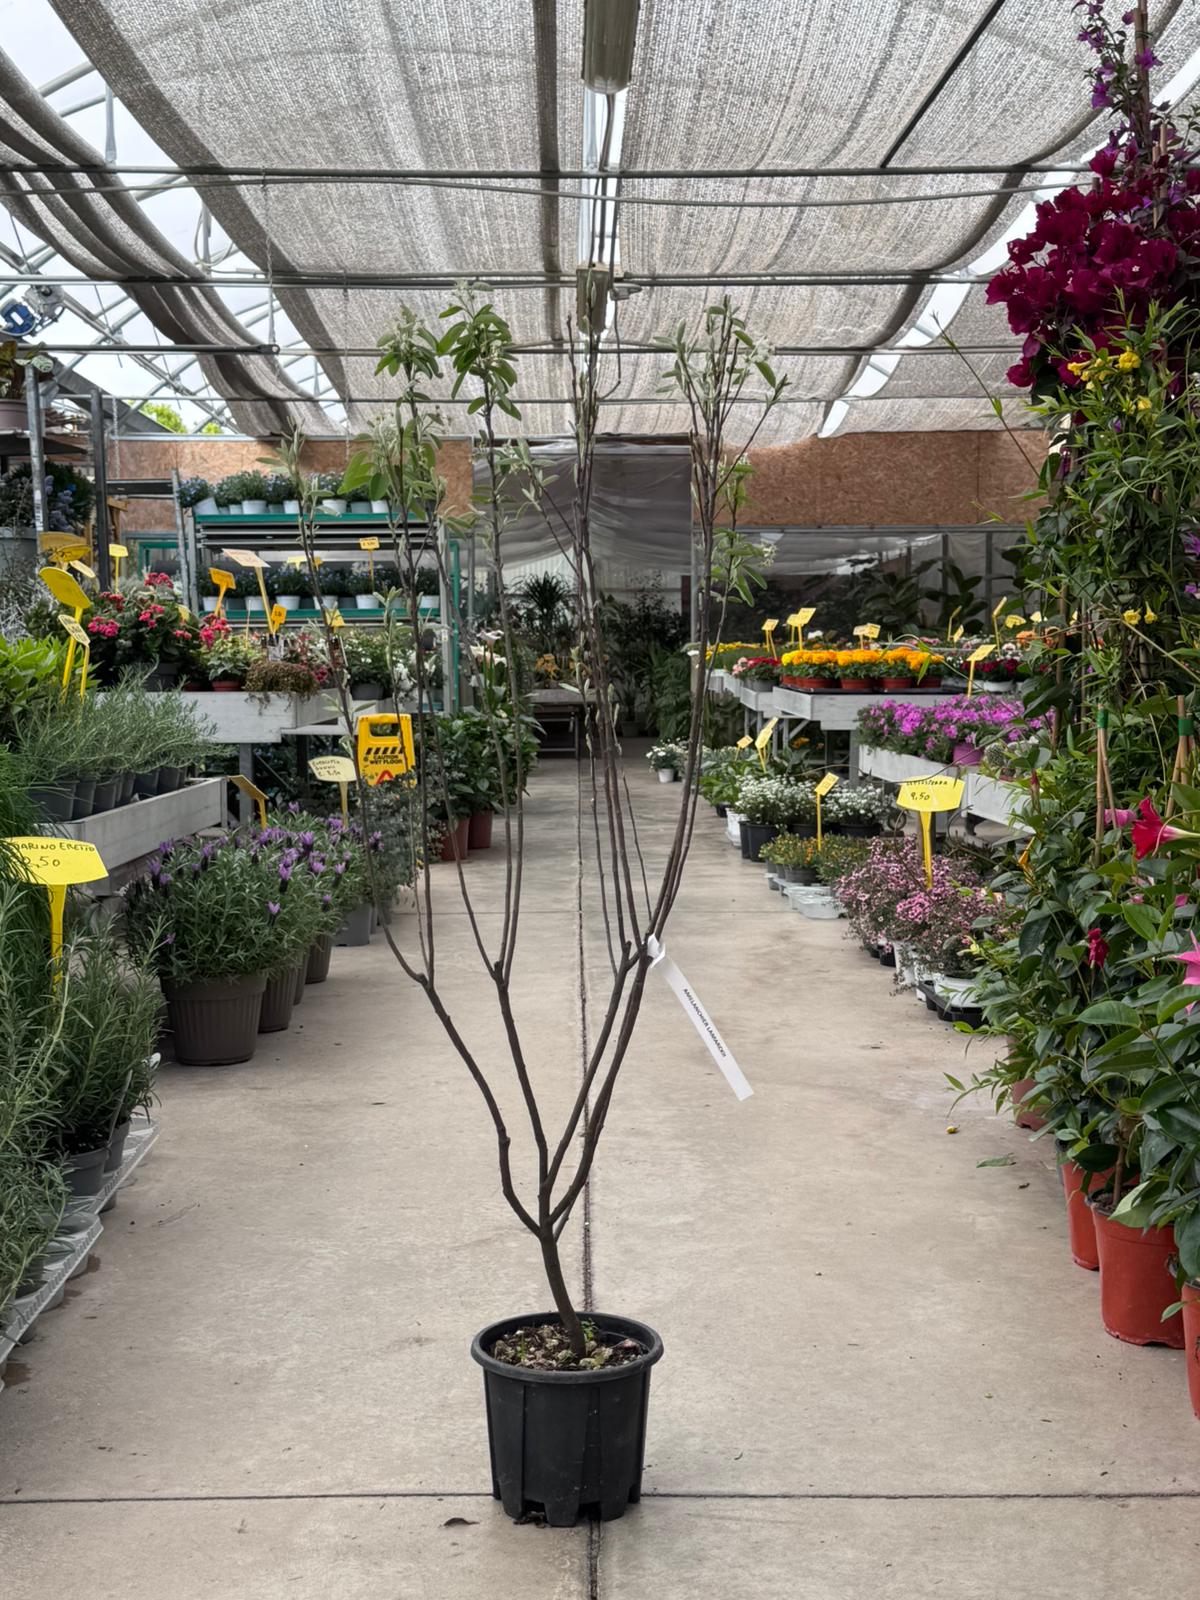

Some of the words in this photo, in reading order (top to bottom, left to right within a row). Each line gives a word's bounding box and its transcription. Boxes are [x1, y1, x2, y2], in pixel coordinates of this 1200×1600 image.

[911, 792, 930, 800] 9,50
[59, 842, 95, 852] ERETTO
[684, 989, 708, 1027] AMELANCHIER
